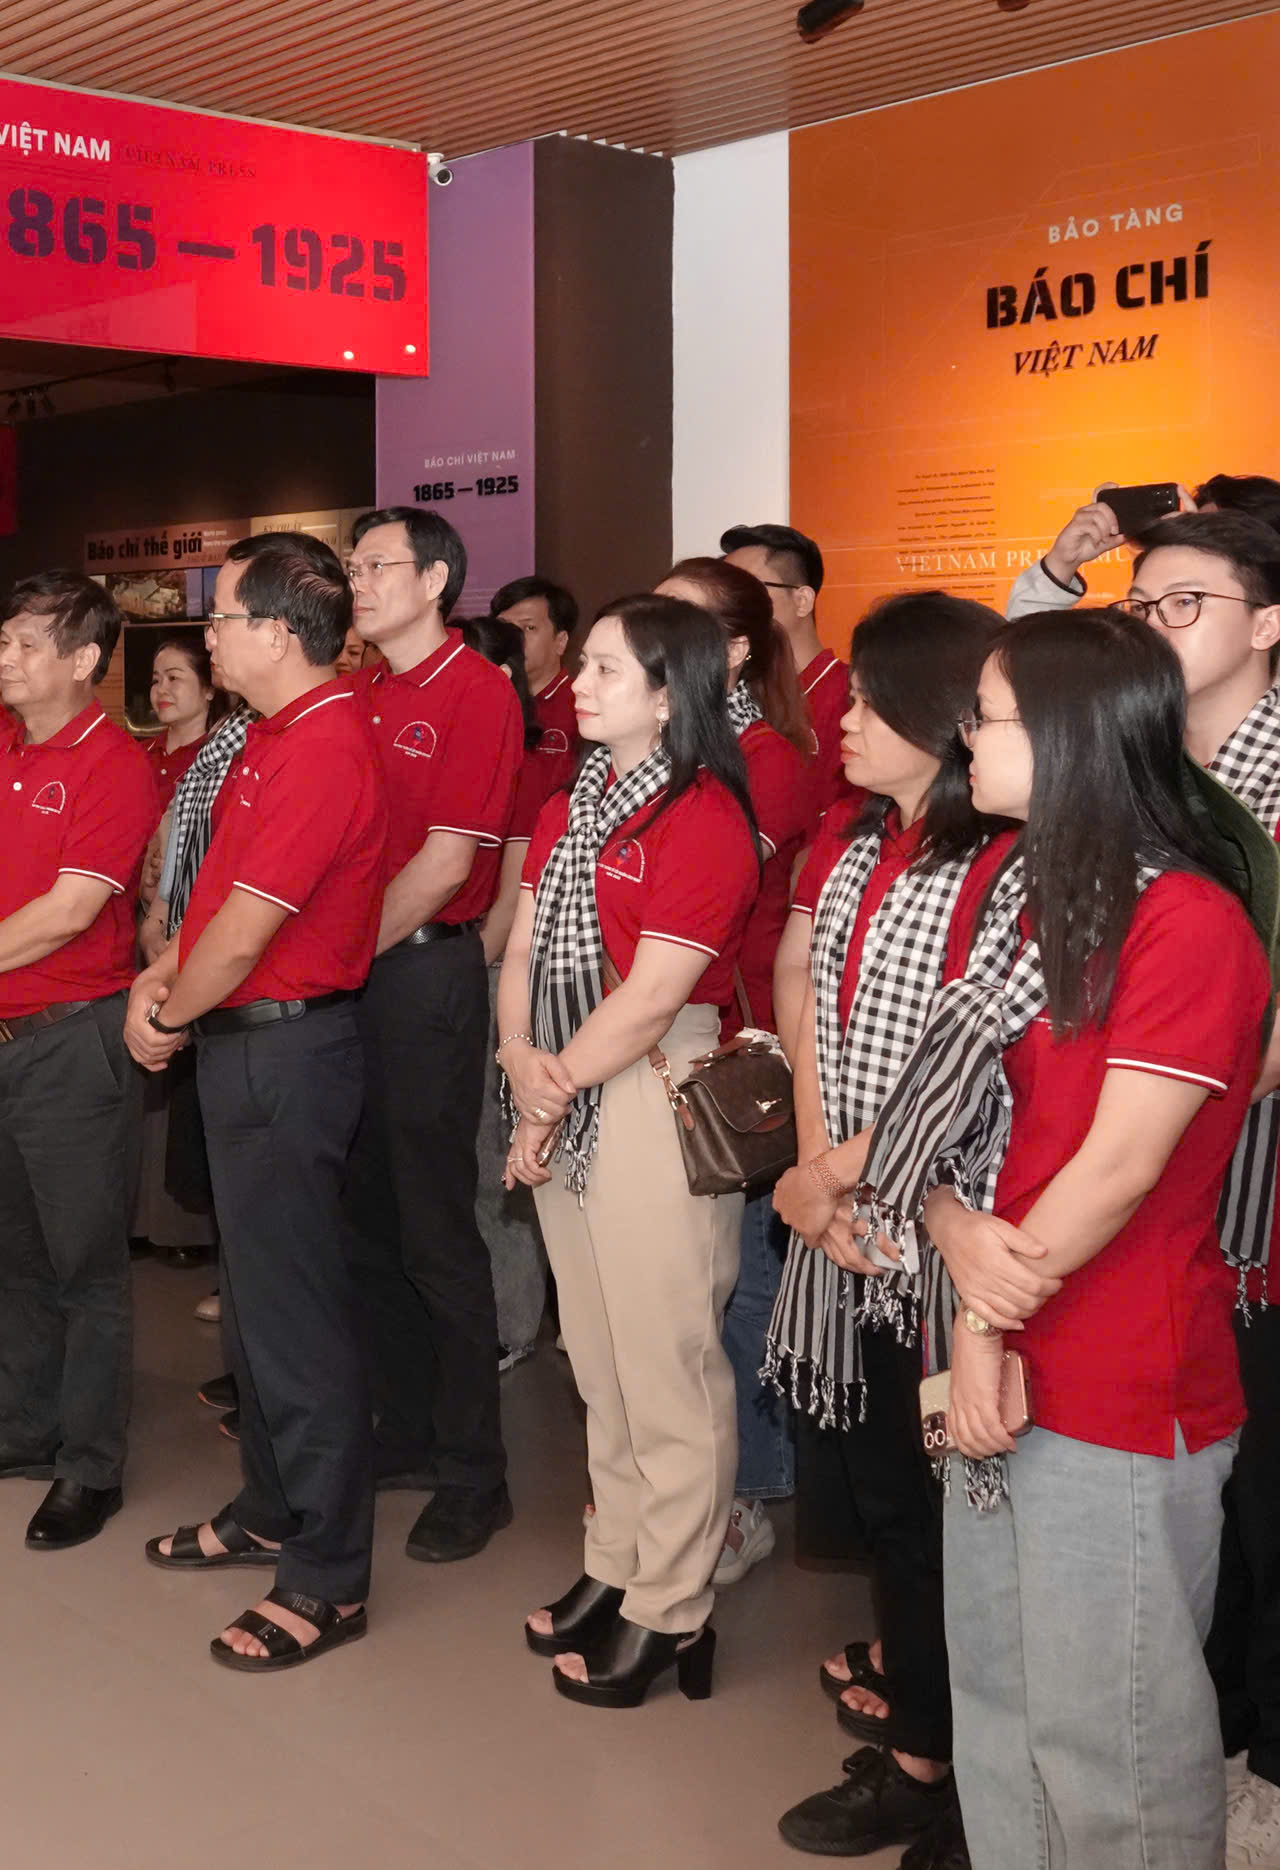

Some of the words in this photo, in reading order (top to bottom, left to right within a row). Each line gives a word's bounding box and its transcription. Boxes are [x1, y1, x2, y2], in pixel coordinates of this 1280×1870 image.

[53, 130, 111, 162] NAM
[1048, 214, 1100, 245] BẢO
[1111, 202, 1184, 234] TÀNG
[250, 223, 407, 302] 1925
[986, 266, 1097, 329] BÁO
[1115, 239, 1213, 310] CHÍ
[1013, 339, 1083, 378] VIỆT
[1087, 333, 1159, 365] NAM
[424, 455, 444, 469] BÁO
[447, 454, 465, 467] CHÍ
[467, 450, 489, 466] VIỆT
[492, 449, 516, 461] NAM
[413, 481, 455, 502] 1865
[475, 475, 519, 497] 1925
[88, 539, 114, 561] Báo
[118, 536, 140, 558] chí
[143, 529, 169, 557] thế
[173, 531, 202, 560] giới
[896, 551, 997, 573] VIETNAM
